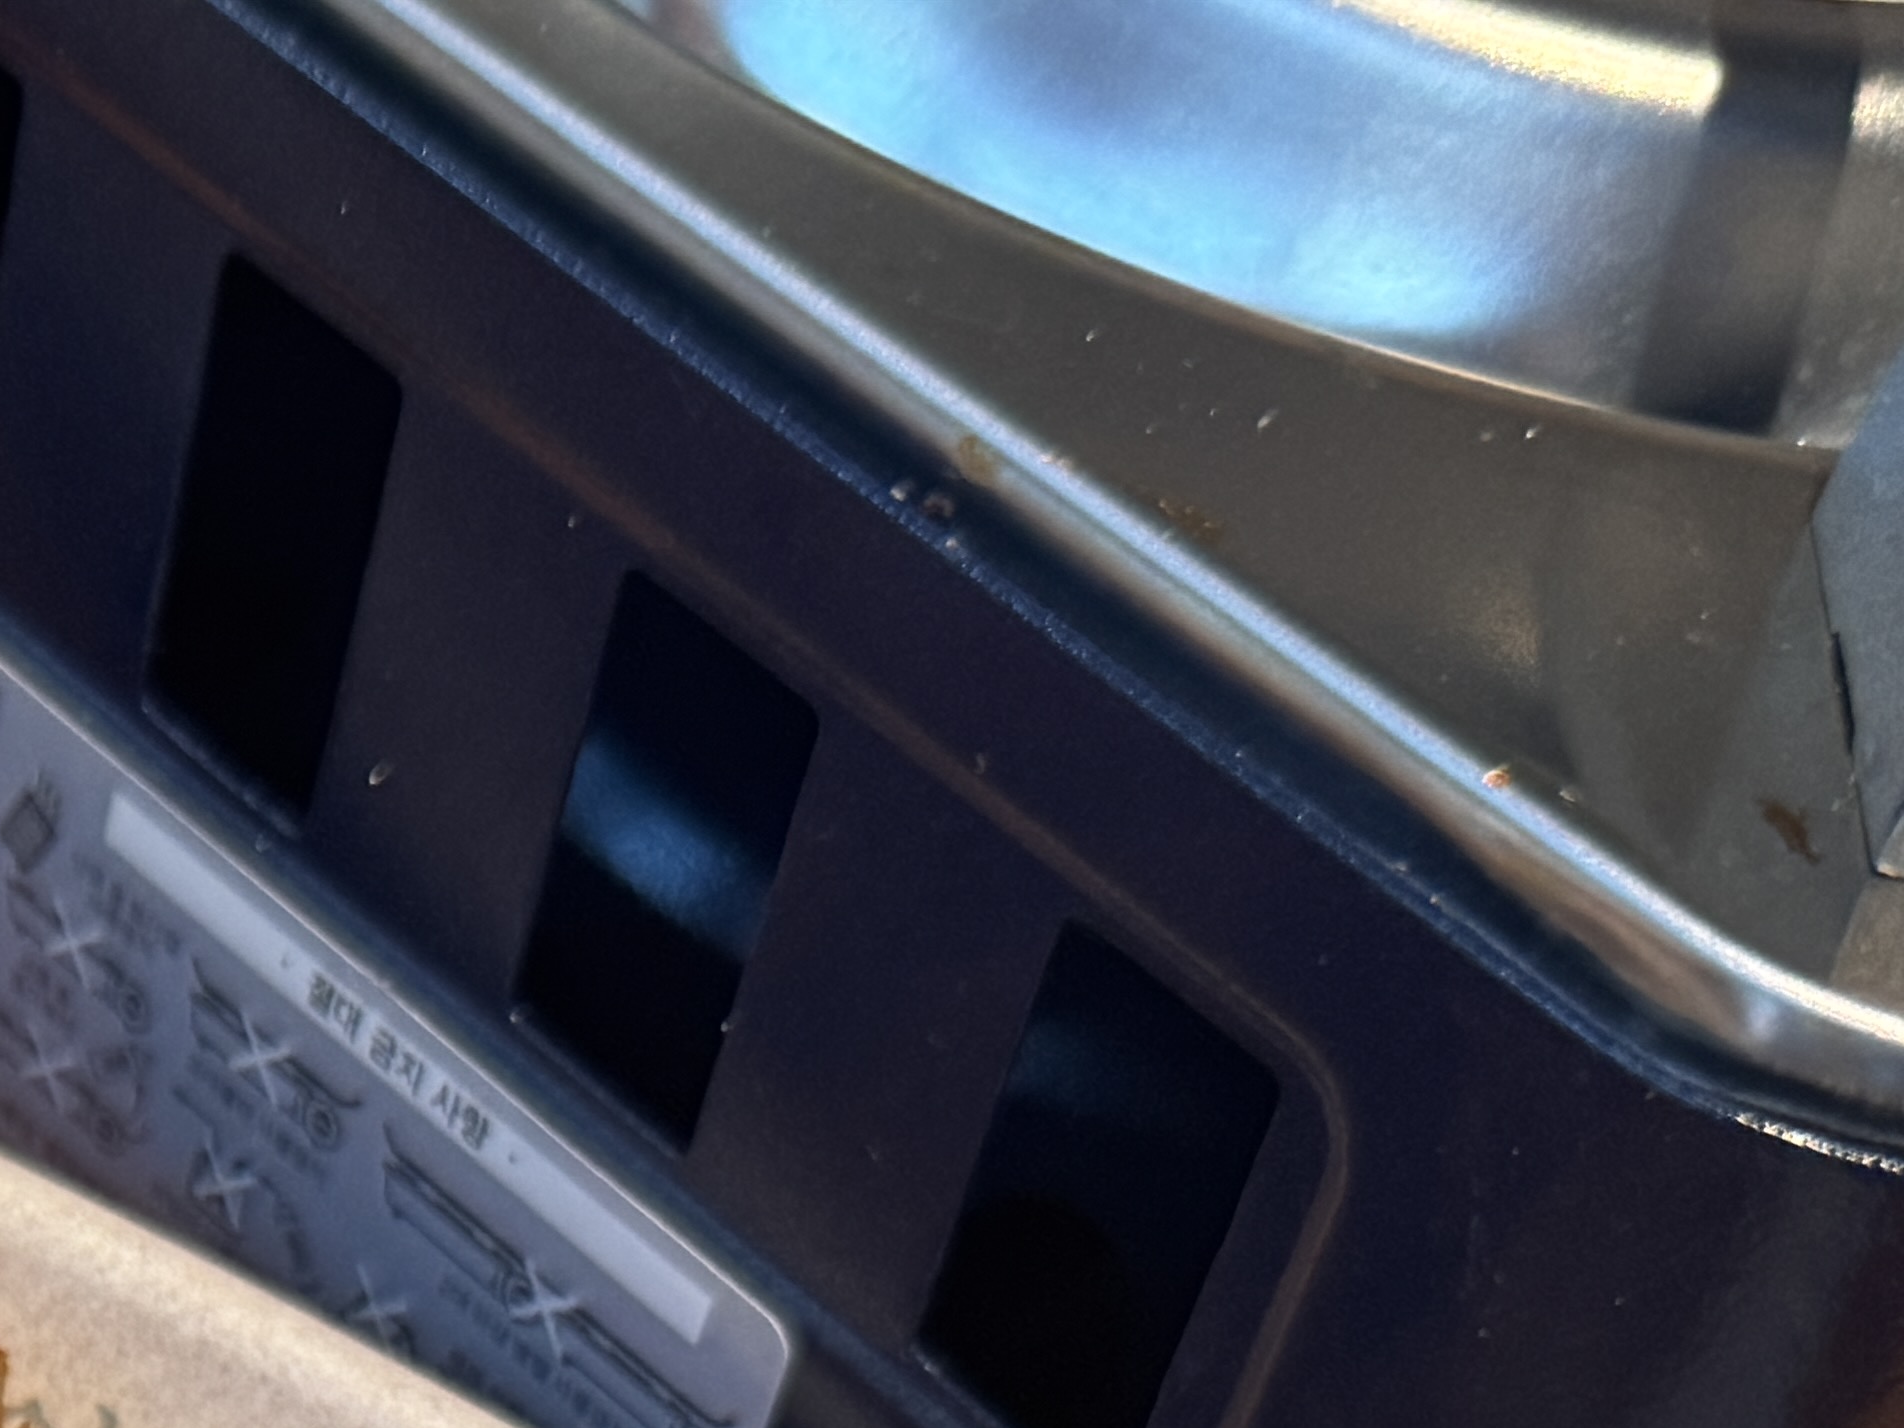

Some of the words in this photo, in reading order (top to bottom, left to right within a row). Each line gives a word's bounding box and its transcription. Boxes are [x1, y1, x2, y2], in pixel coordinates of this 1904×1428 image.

[307, 969, 365, 1046] 절대
[369, 1025, 427, 1098] 금지
[430, 1081, 492, 1152] 사항
